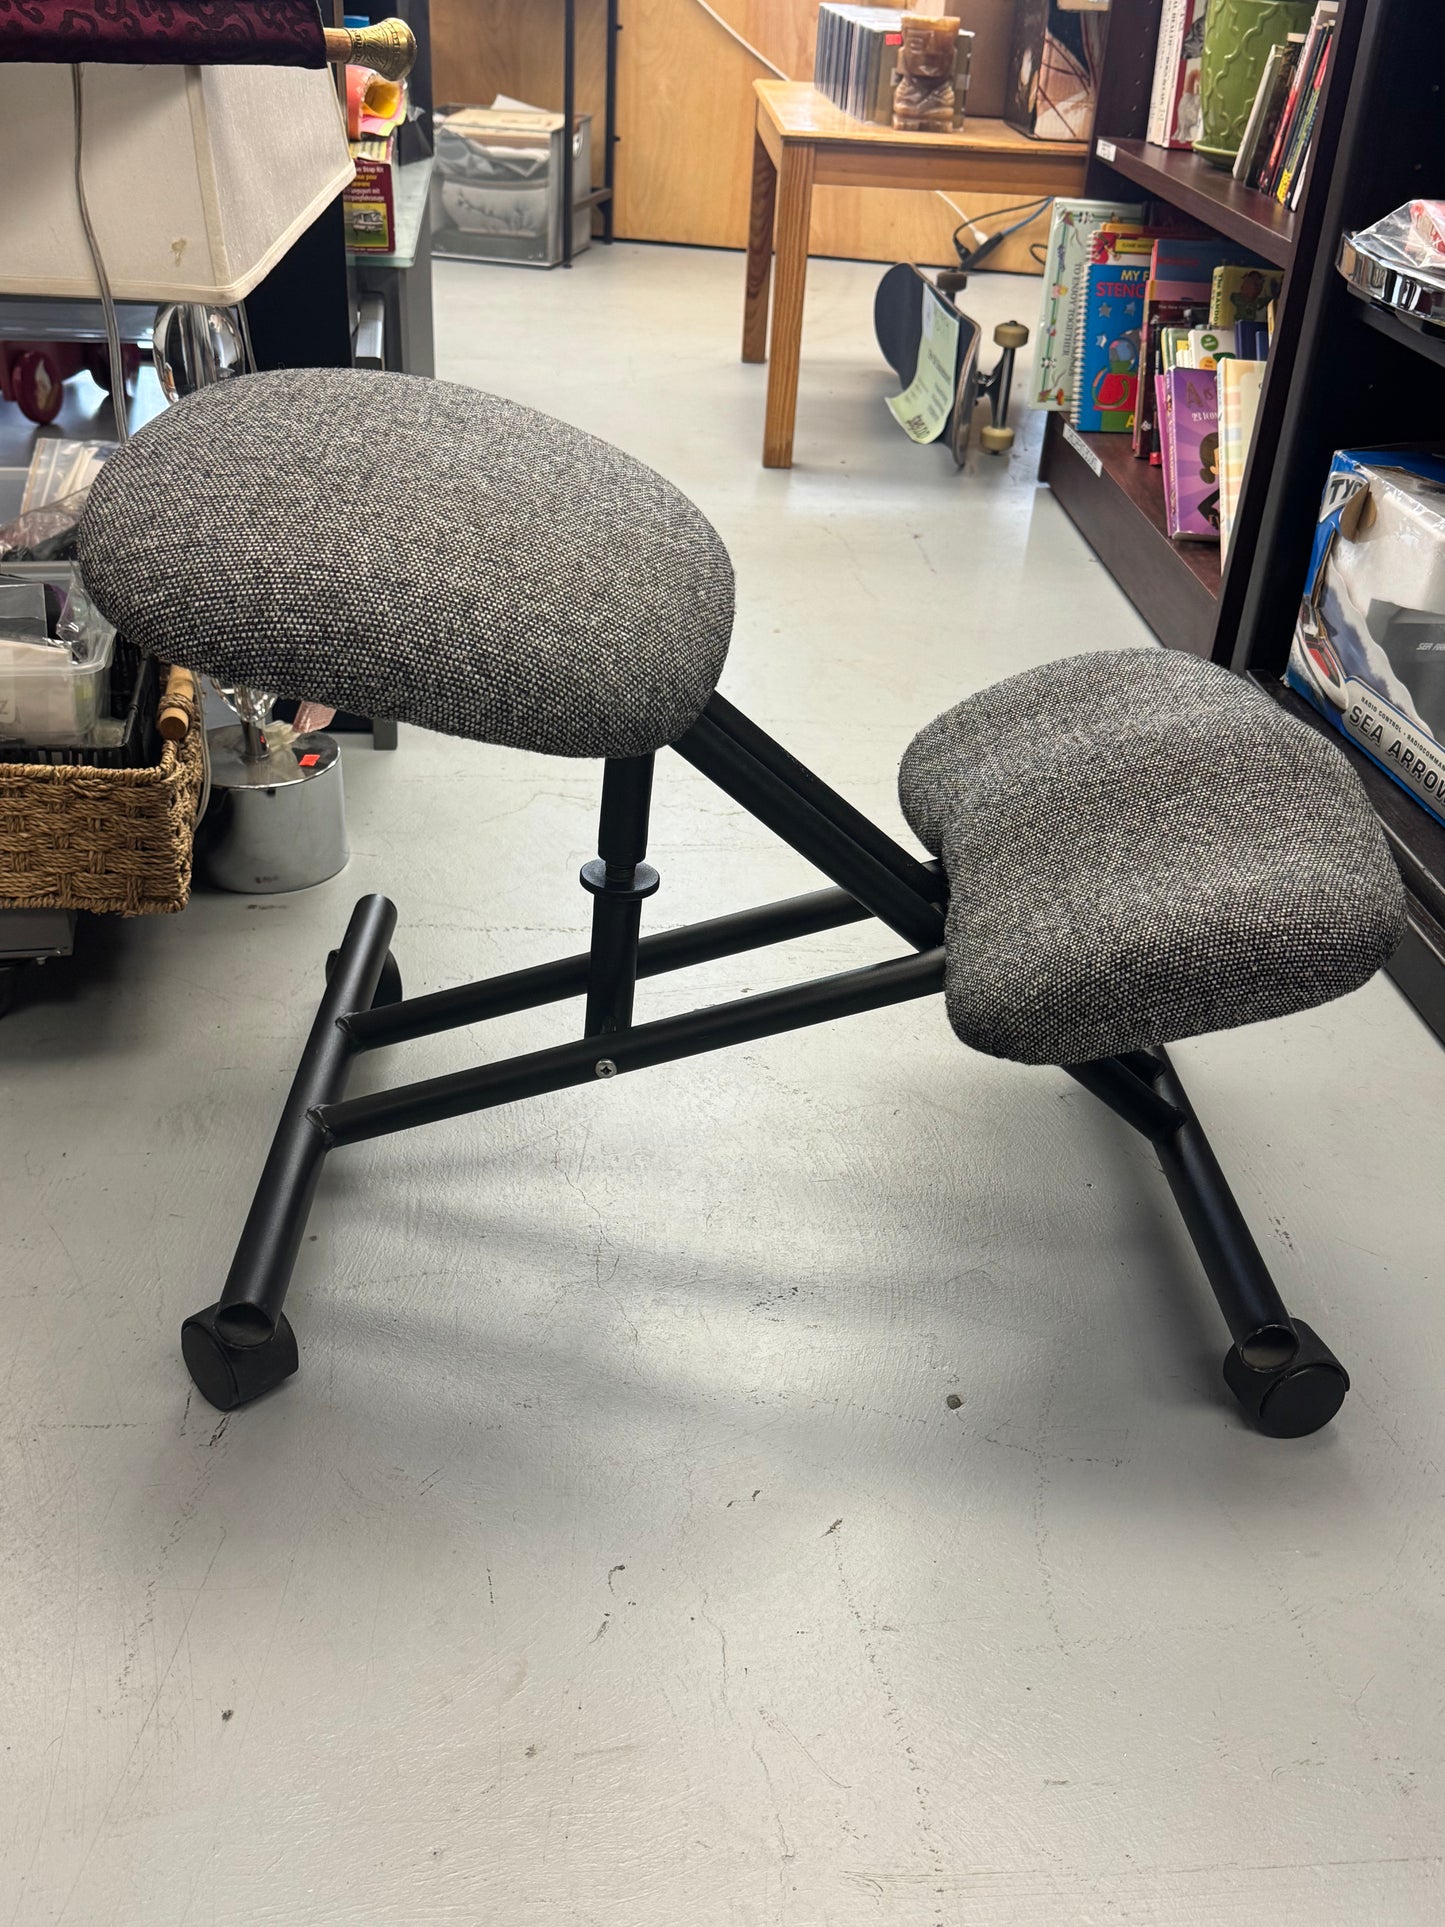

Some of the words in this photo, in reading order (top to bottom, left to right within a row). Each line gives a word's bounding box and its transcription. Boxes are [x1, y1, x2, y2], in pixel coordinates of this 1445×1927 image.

[1120, 269, 1139, 281] MY
[1068, 277, 1079, 306] ENJOY
[1061, 306, 1075, 357] TOGETHER
[1185, 380, 1204, 408] A
[1191, 412, 1202, 422] 23
[1349, 705, 1384, 744] SEA
[1361, 696, 1377, 713] RADIO
[1378, 710, 1402, 734] CONTROL
